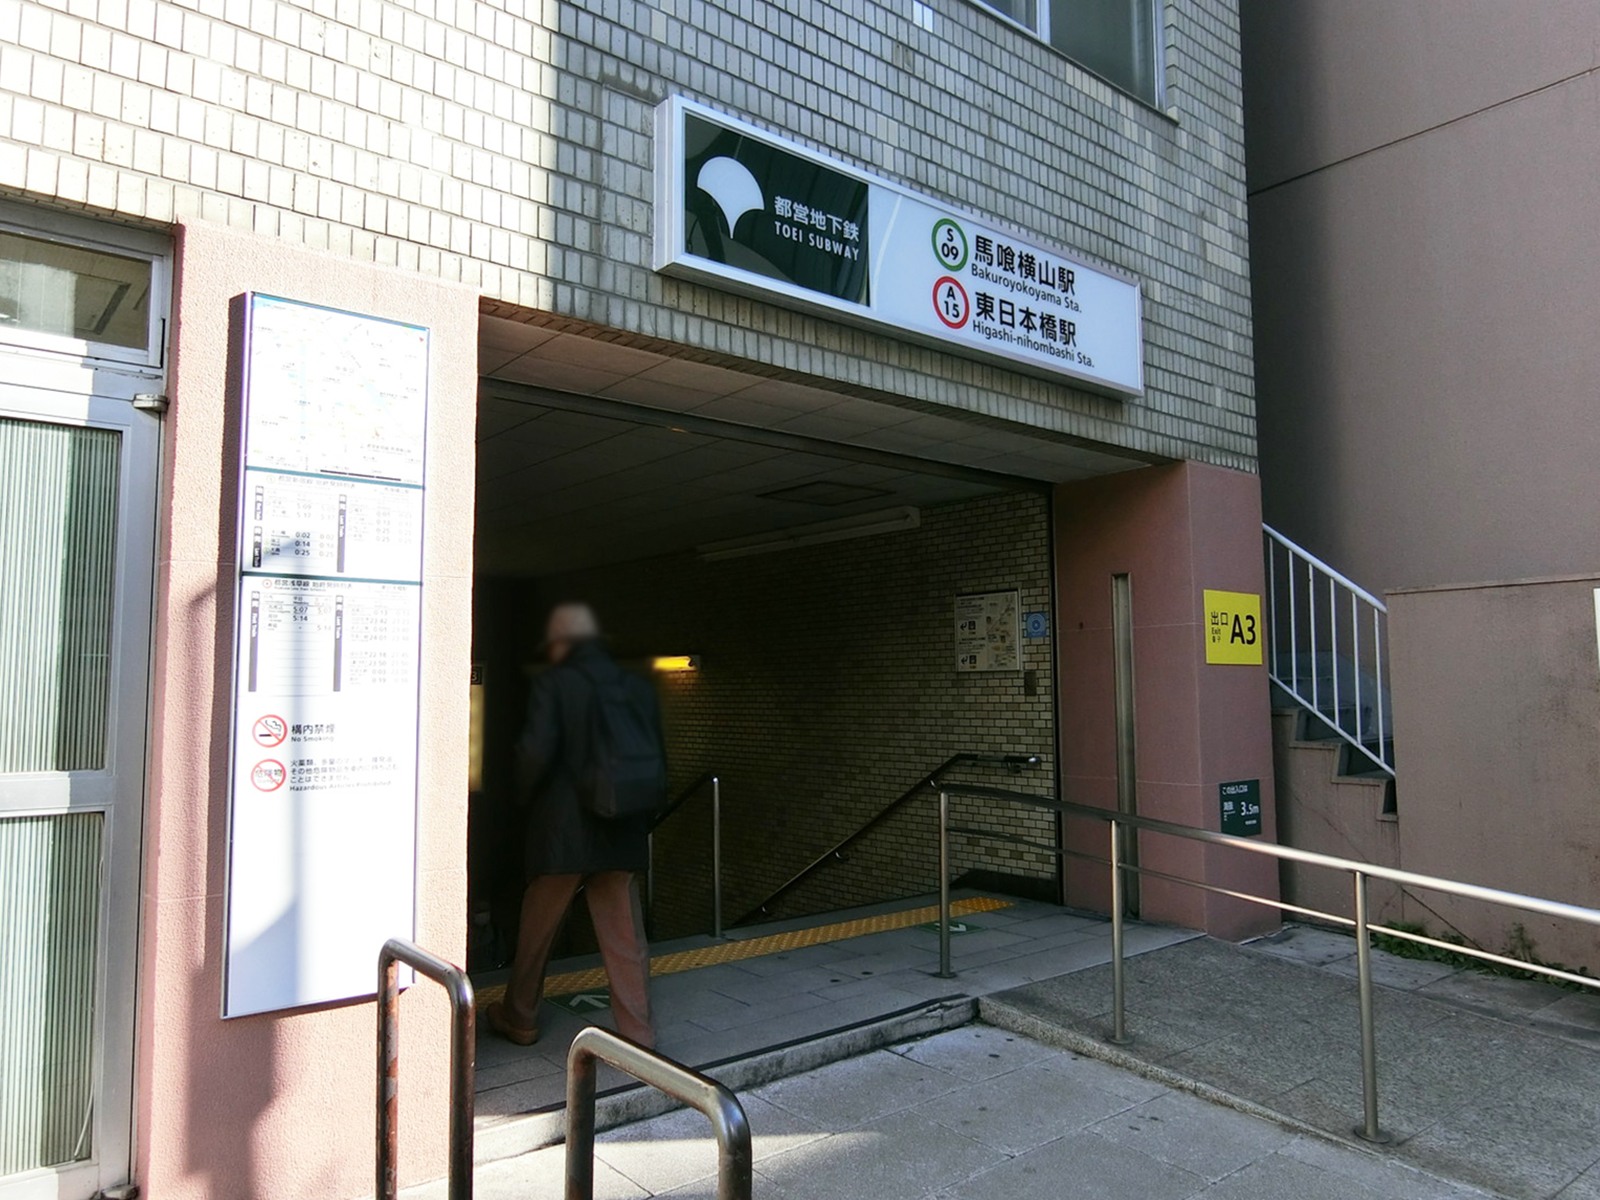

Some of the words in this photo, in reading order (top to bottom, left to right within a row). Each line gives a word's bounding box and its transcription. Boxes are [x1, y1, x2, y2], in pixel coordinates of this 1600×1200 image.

[774, 195, 860, 243] 都営地下鉄
[774, 220, 805, 245] TOEI
[808, 229, 860, 262] SUBWAY
[946, 228, 954, 242] S
[941, 241, 959, 261] 09
[974, 234, 1076, 296] 馬喰横山駅
[946, 286, 956, 300] A
[971, 263, 1061, 306] Bakuroyokoyama
[1064, 296, 1082, 313] Sta.
[943, 300, 960, 319] 15
[974, 291, 1077, 347] 東日本橋駅
[972, 319, 1075, 363] Higashi-nihombashi
[1077, 351, 1094, 368] Sta.
[1211, 611, 1229, 626] 出口
[1231, 614, 1256, 645] A3
[291, 724, 335, 735] 構内禁煙
[1240, 801, 1259, 816] 3.5m
